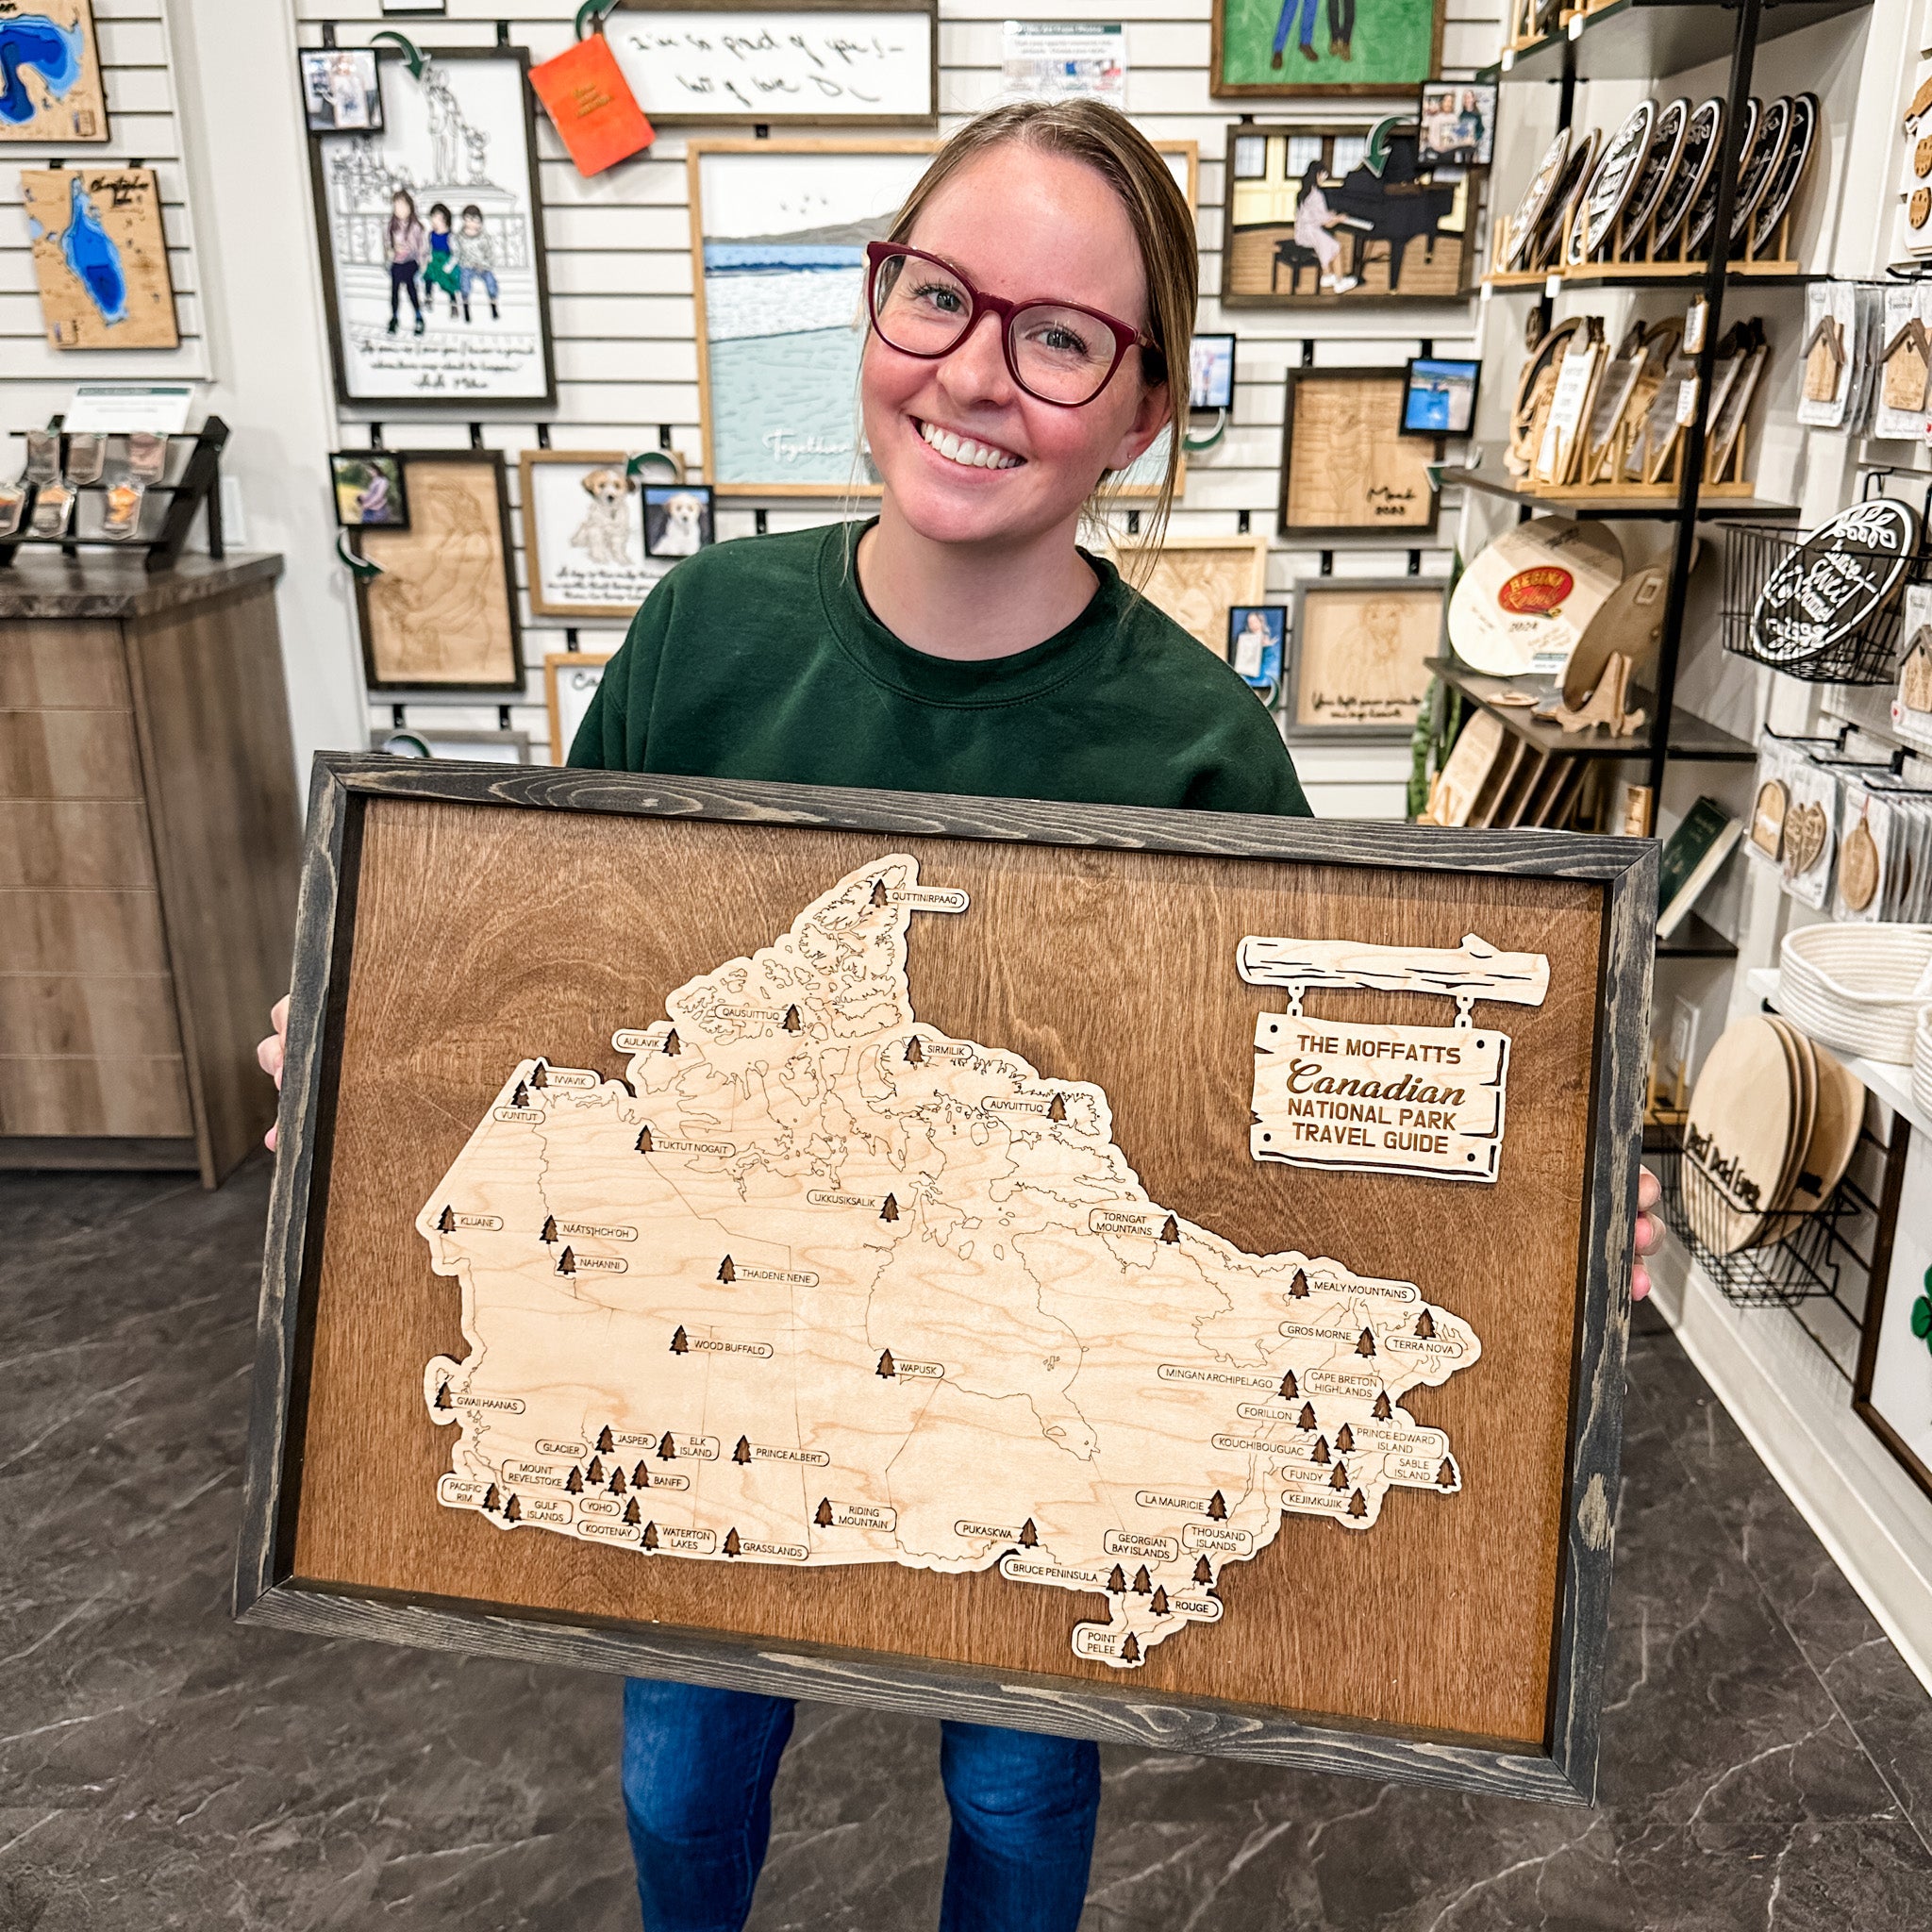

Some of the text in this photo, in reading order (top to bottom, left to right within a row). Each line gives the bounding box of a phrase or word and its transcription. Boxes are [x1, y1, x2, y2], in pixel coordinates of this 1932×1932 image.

[891, 891, 958, 906] QUTTINIRPAAQ
[722, 1007, 779, 1022] QAUSUITTUQ
[624, 1038, 659, 1049] AULAVIK
[1297, 1034, 1460, 1064] THE MOFFATTS
[927, 1044, 965, 1057] SIRMILIK
[1287, 1058, 1466, 1106] Canadian
[991, 1101, 1043, 1114] AUYUITTUQ
[1288, 1098, 1457, 1130] NATIONAL PARK
[501, 1111, 538, 1123] VUNTUT
[1292, 1122, 1448, 1154] TRAVEL GUIDE
[658, 1141, 727, 1155] TUKTUT NOGAIT
[814, 1193, 875, 1208] UKKUSIKSALIK
[461, 1217, 494, 1227] KLUANE
[1103, 1212, 1147, 1224] TORNGAT
[1096, 1223, 1153, 1236] MOUNTAINS
[580, 1258, 620, 1270] NAHANNI
[742, 1269, 810, 1283] THAIDENE NENE
[1314, 1281, 1407, 1299] MEALY MOUNTAINS
[1288, 1326, 1352, 1341] GROS MORNE
[694, 1340, 765, 1356] WOOD BUFFALO
[1393, 1340, 1454, 1355] TERRA NOVA
[900, 1363, 937, 1375] WAPUSK
[1166, 1369, 1274, 1389] MINGAN ARCHIPELAGO
[1311, 1372, 1377, 1388] CAPE BRETON
[1314, 1384, 1373, 1398] HIGHLANDS
[457, 1396, 518, 1410] GWAII HAANAS
[1244, 1407, 1292, 1421] FORILLON
[618, 1435, 649, 1445] JASPER
[690, 1437, 707, 1447] ELK
[1357, 1428, 1436, 1445] PRINCE EDWARD
[543, 1442, 579, 1455] GLACIER
[680, 1447, 712, 1458] ISLAND
[1219, 1438, 1305, 1457] KOUCHIBOUGUAC
[1377, 1441, 1413, 1454] ISLAND
[757, 1448, 822, 1463] PRINCE ALBERT
[520, 1463, 553, 1474] MOUNT
[1399, 1458, 1429, 1470] SABLE
[508, 1472, 562, 1487] REVELSTOKE
[1290, 1471, 1323, 1482] FUNDY
[1394, 1469, 1430, 1481] ISLAND
[449, 1482, 482, 1492] PACIFIC
[655, 1476, 681, 1488] BANFF
[457, 1492, 473, 1503] RIM
[1145, 1494, 1204, 1510] LA MAURICIE
[1289, 1494, 1342, 1509] KEJIMKUJIK
[535, 1500, 558, 1510] GULF
[588, 1501, 612, 1512] YOHO
[527, 1510, 564, 1522] ISLANDS
[849, 1506, 879, 1518] RIDING
[839, 1516, 888, 1529] MOUNTAIN
[586, 1524, 632, 1538] KOOTENAY
[662, 1526, 710, 1541] WATERTON
[963, 1524, 1012, 1539] PUKASKWA
[1191, 1526, 1245, 1541] THOUSAND
[671, 1539, 698, 1550] LAKES
[1118, 1534, 1167, 1547] GEORGIAN
[1196, 1540, 1237, 1551] ISLANDS
[743, 1542, 803, 1557] GRASSLANDS
[1112, 1544, 1170, 1559] BAY ISLANDS
[1013, 1563, 1098, 1582] BRUCE PENINSULA
[1175, 1601, 1208, 1613] ROUGE
[1088, 1632, 1117, 1643] POINT
[1088, 1642, 1115, 1655] PELEE
